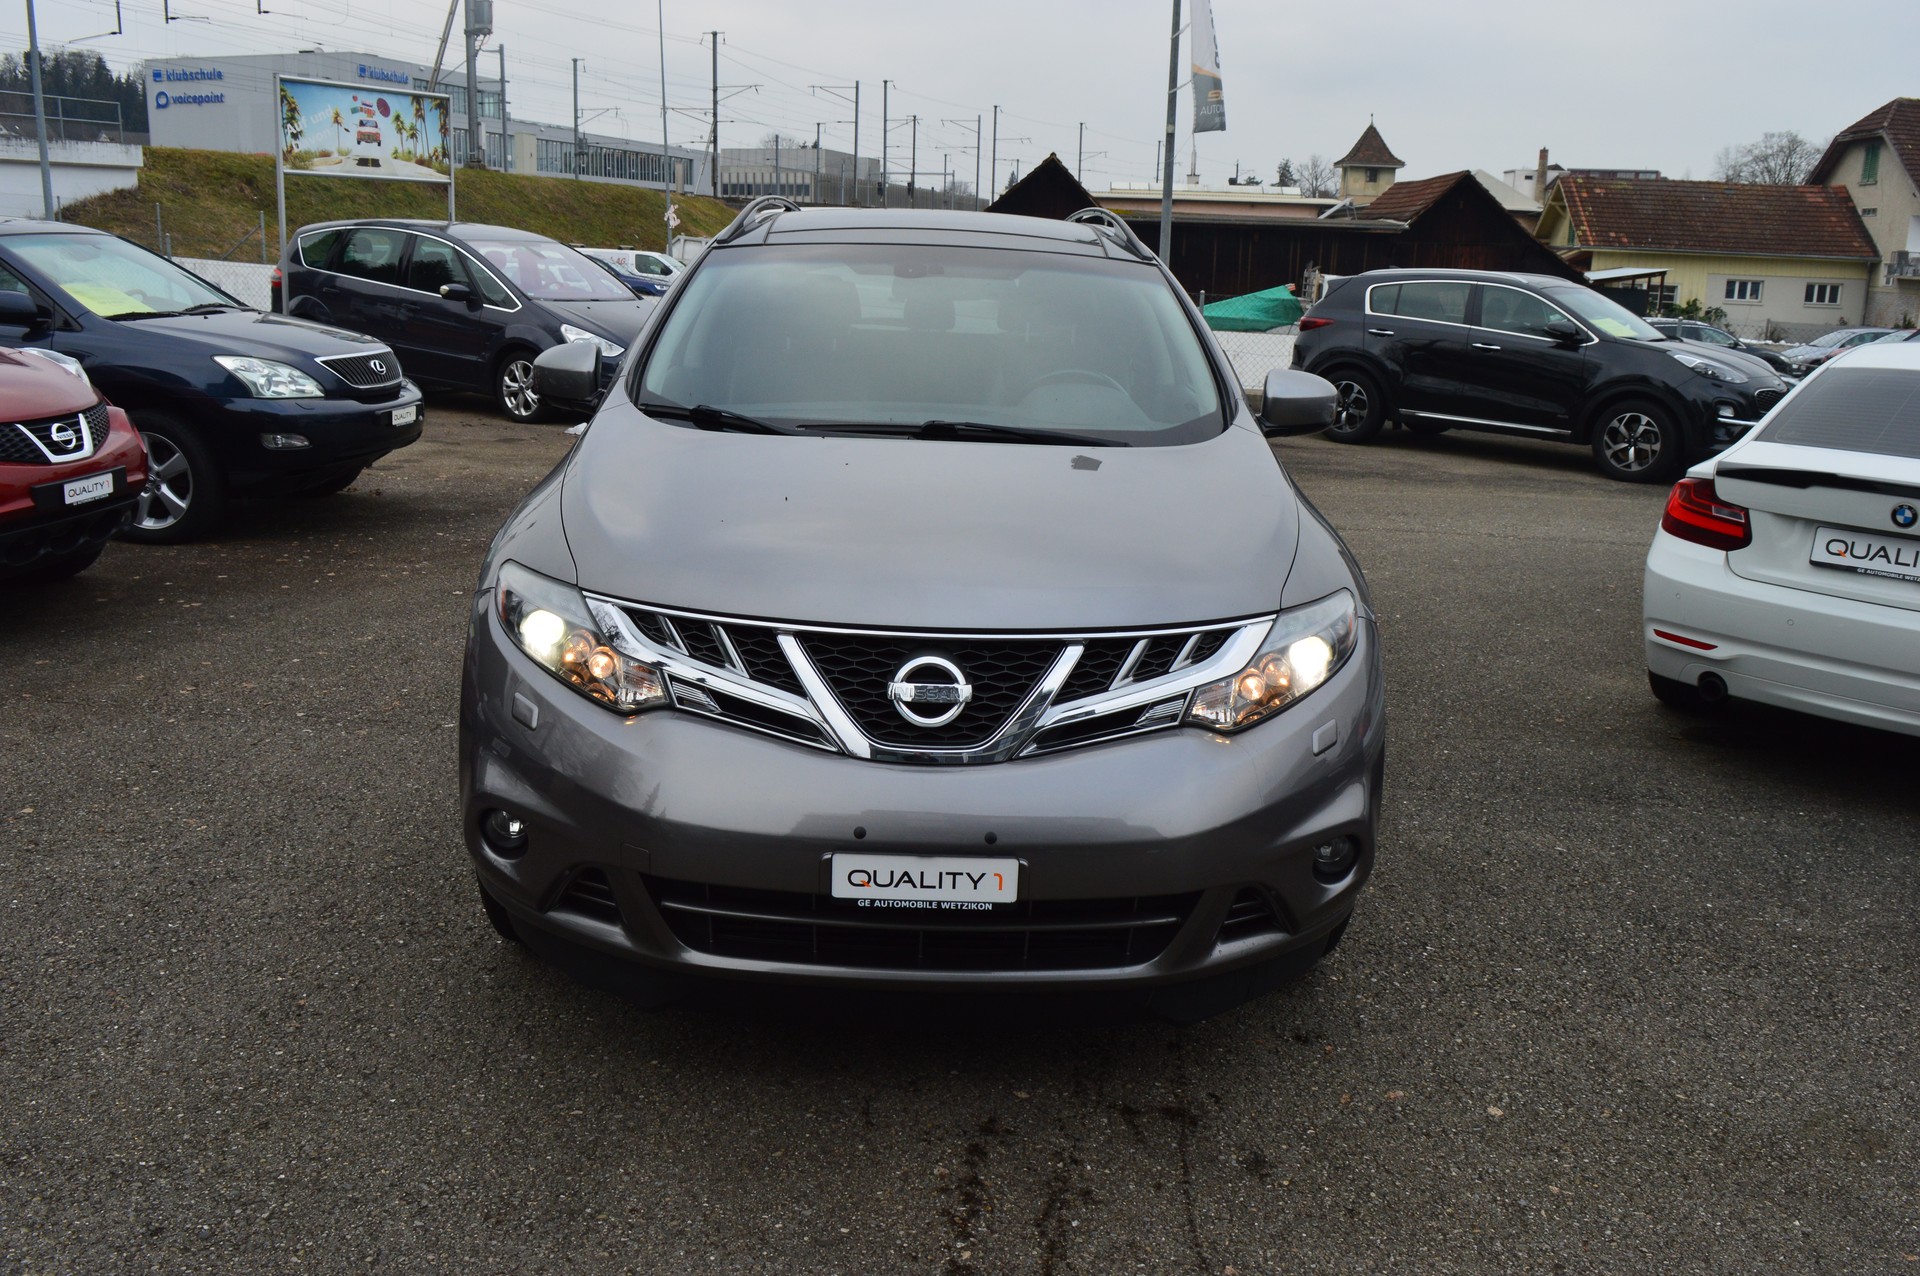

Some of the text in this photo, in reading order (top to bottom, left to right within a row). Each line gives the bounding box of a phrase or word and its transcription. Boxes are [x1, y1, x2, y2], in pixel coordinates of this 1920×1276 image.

[166, 67, 224, 81] klubschule
[171, 90, 225, 106] voicepoint
[285, 104, 332, 136] Auf und
[68, 479, 110, 498] QUALITY 1
[1866, 568, 1903, 579] AUTOMOBILE
[895, 686, 964, 700] NISSAN
[847, 869, 1003, 891] QUALITY 1
[857, 899, 993, 911] GE AUTOMOBILE WETZIKON
